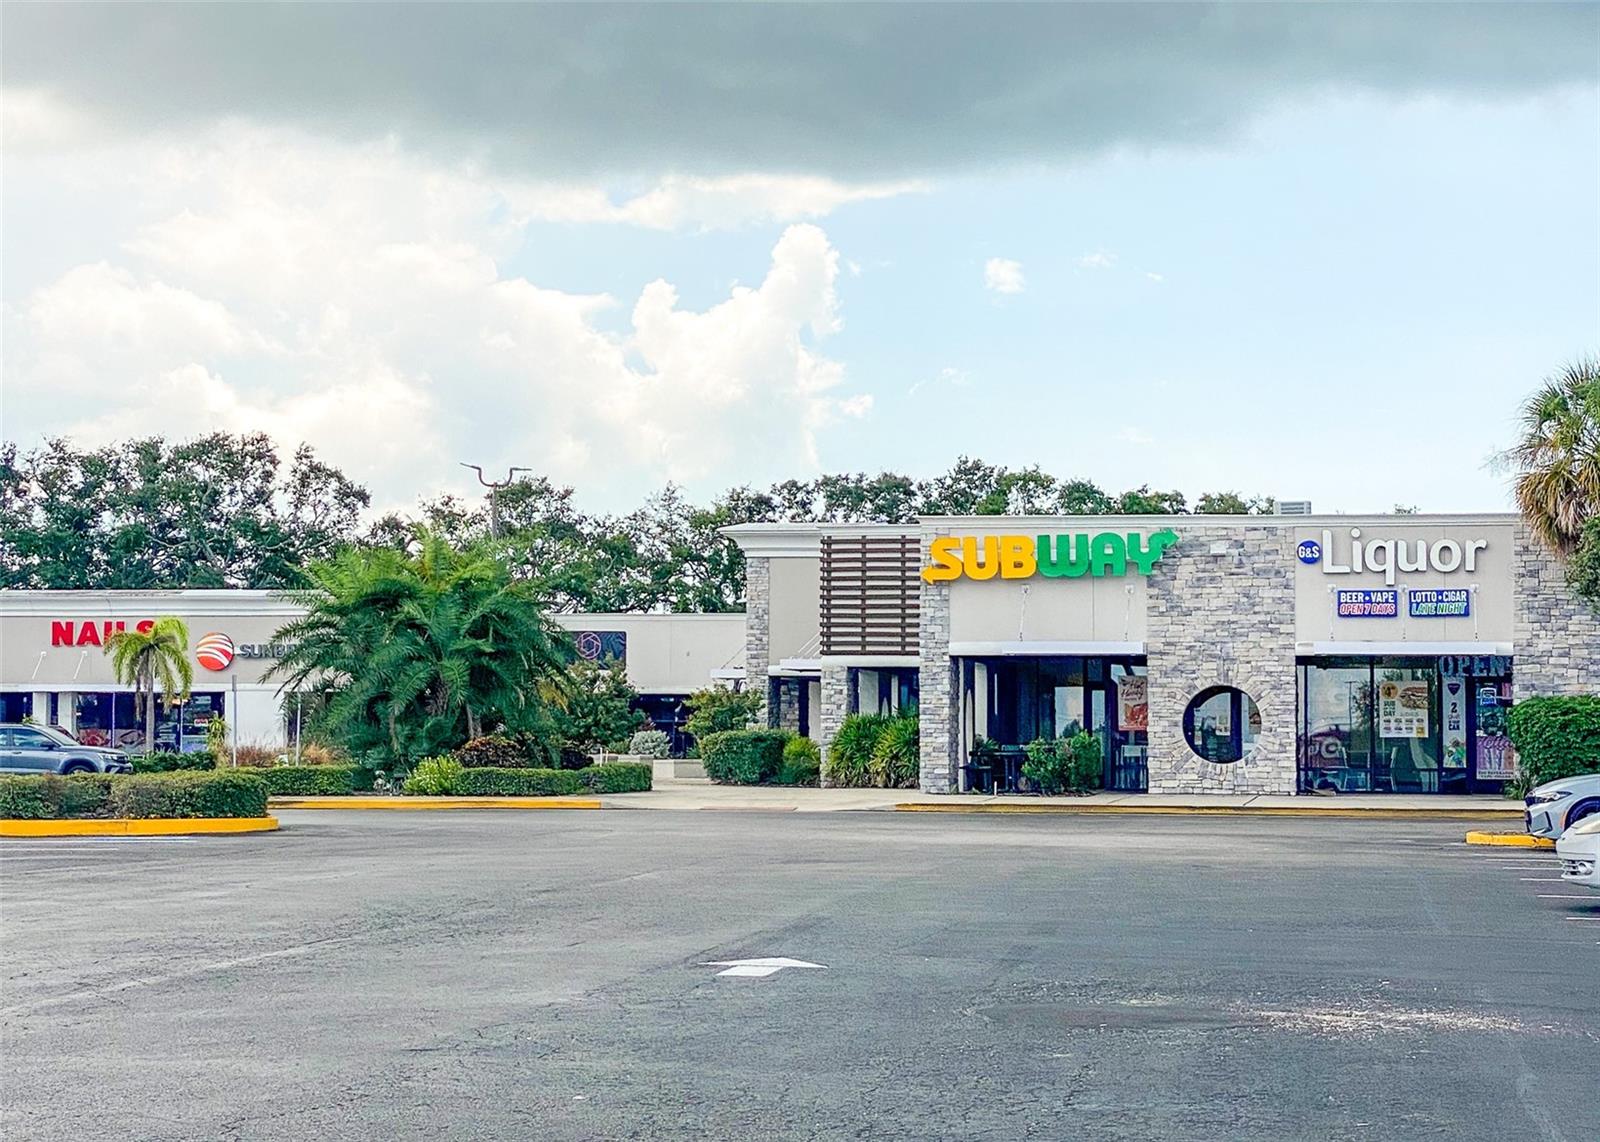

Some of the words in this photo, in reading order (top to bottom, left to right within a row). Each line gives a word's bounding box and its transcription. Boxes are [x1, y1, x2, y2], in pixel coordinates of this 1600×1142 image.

[921, 529, 1179, 584] SUBWAY
[1299, 545, 1320, 559] G&S
[1322, 527, 1488, 586] Liquor
[1340, 592, 1364, 602] BEER
[1371, 592, 1394, 602] VAPE
[1410, 591, 1437, 602] LOTTO
[1442, 591, 1467, 602] CIGAR
[1339, 603, 1364, 615] OPEN
[1364, 603, 1371, 615] 7
[1370, 603, 1396, 615] DAYS
[1411, 603, 1436, 615] LATE
[1436, 603, 1467, 615] NIGHT
[1439, 655, 1505, 677] OPEN
[1451, 702, 1458, 713] 2
